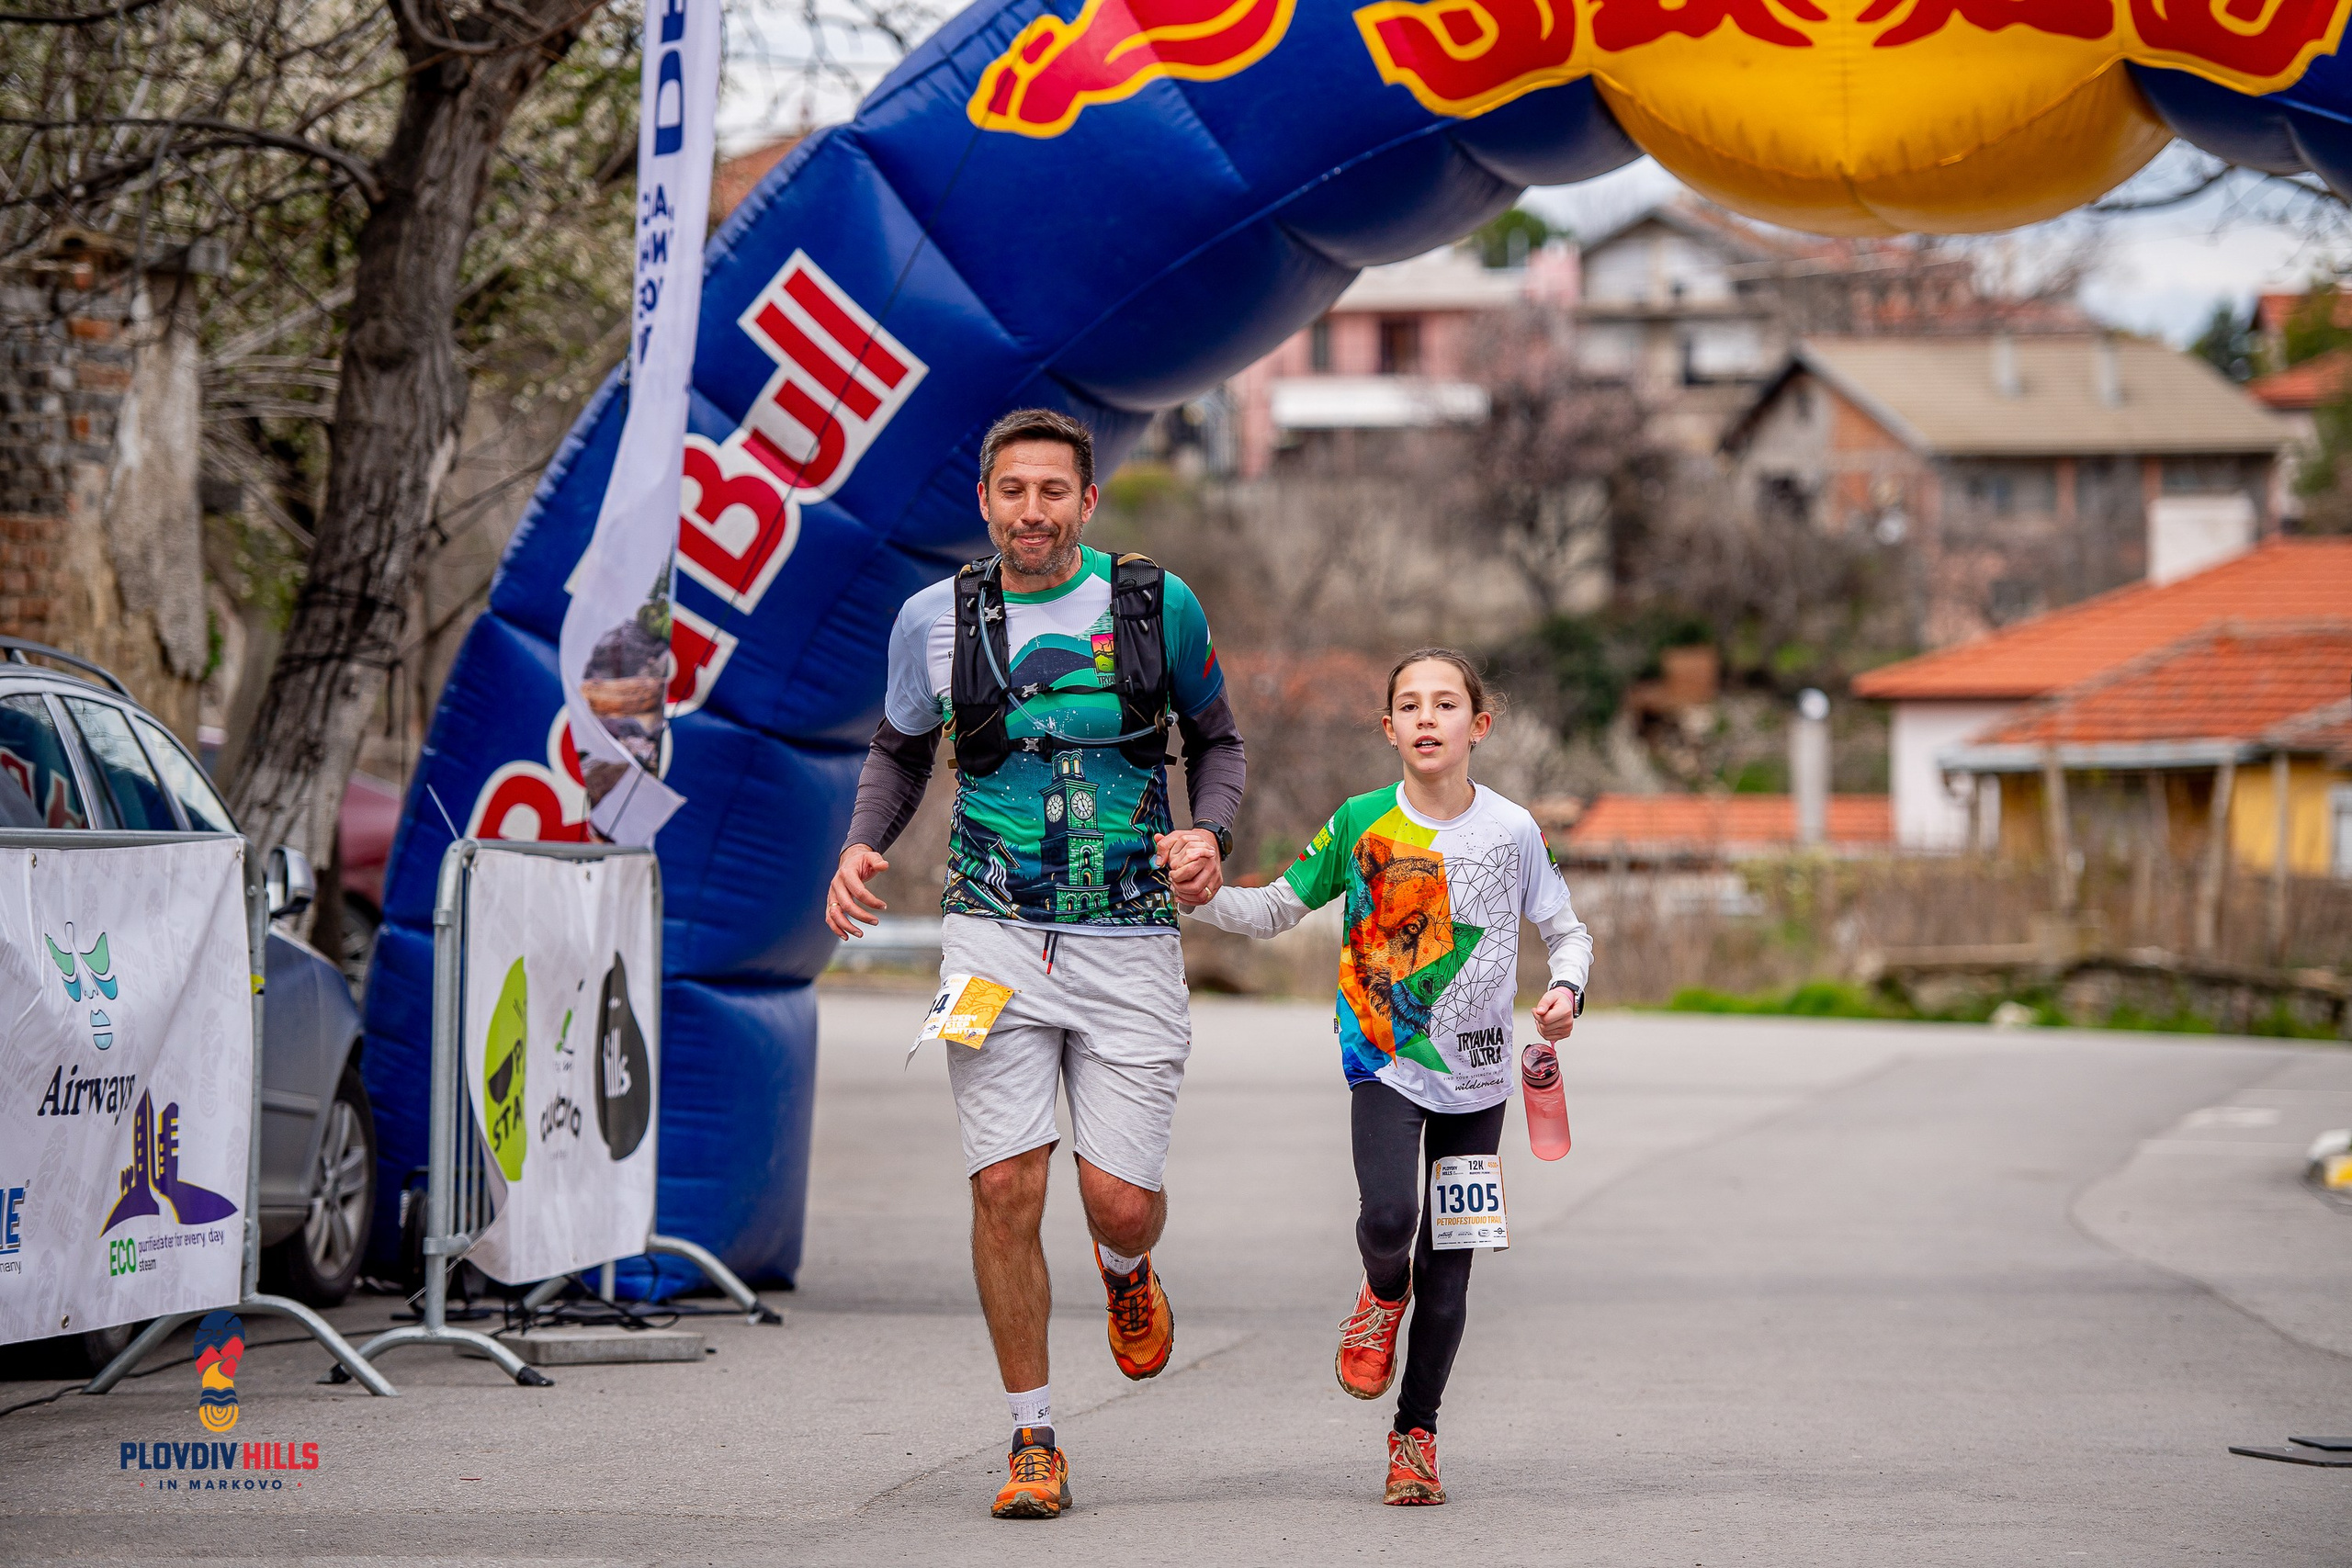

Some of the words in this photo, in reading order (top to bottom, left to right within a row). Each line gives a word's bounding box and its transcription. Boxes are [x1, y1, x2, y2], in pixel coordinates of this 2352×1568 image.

[678, 268, 910, 597] Bull
[1456, 1027, 1504, 1052] TRYAVNA
[1469, 1045, 1502, 1068] ULTRA
[38, 1065, 136, 1125] Airways
[1454, 1077, 1504, 1091] wilderness
[1468, 1160, 1485, 1170] 12K
[1436, 1183, 1499, 1214] 1305
[109, 1237, 137, 1277] ECO
[208, 1227, 225, 1246] day
